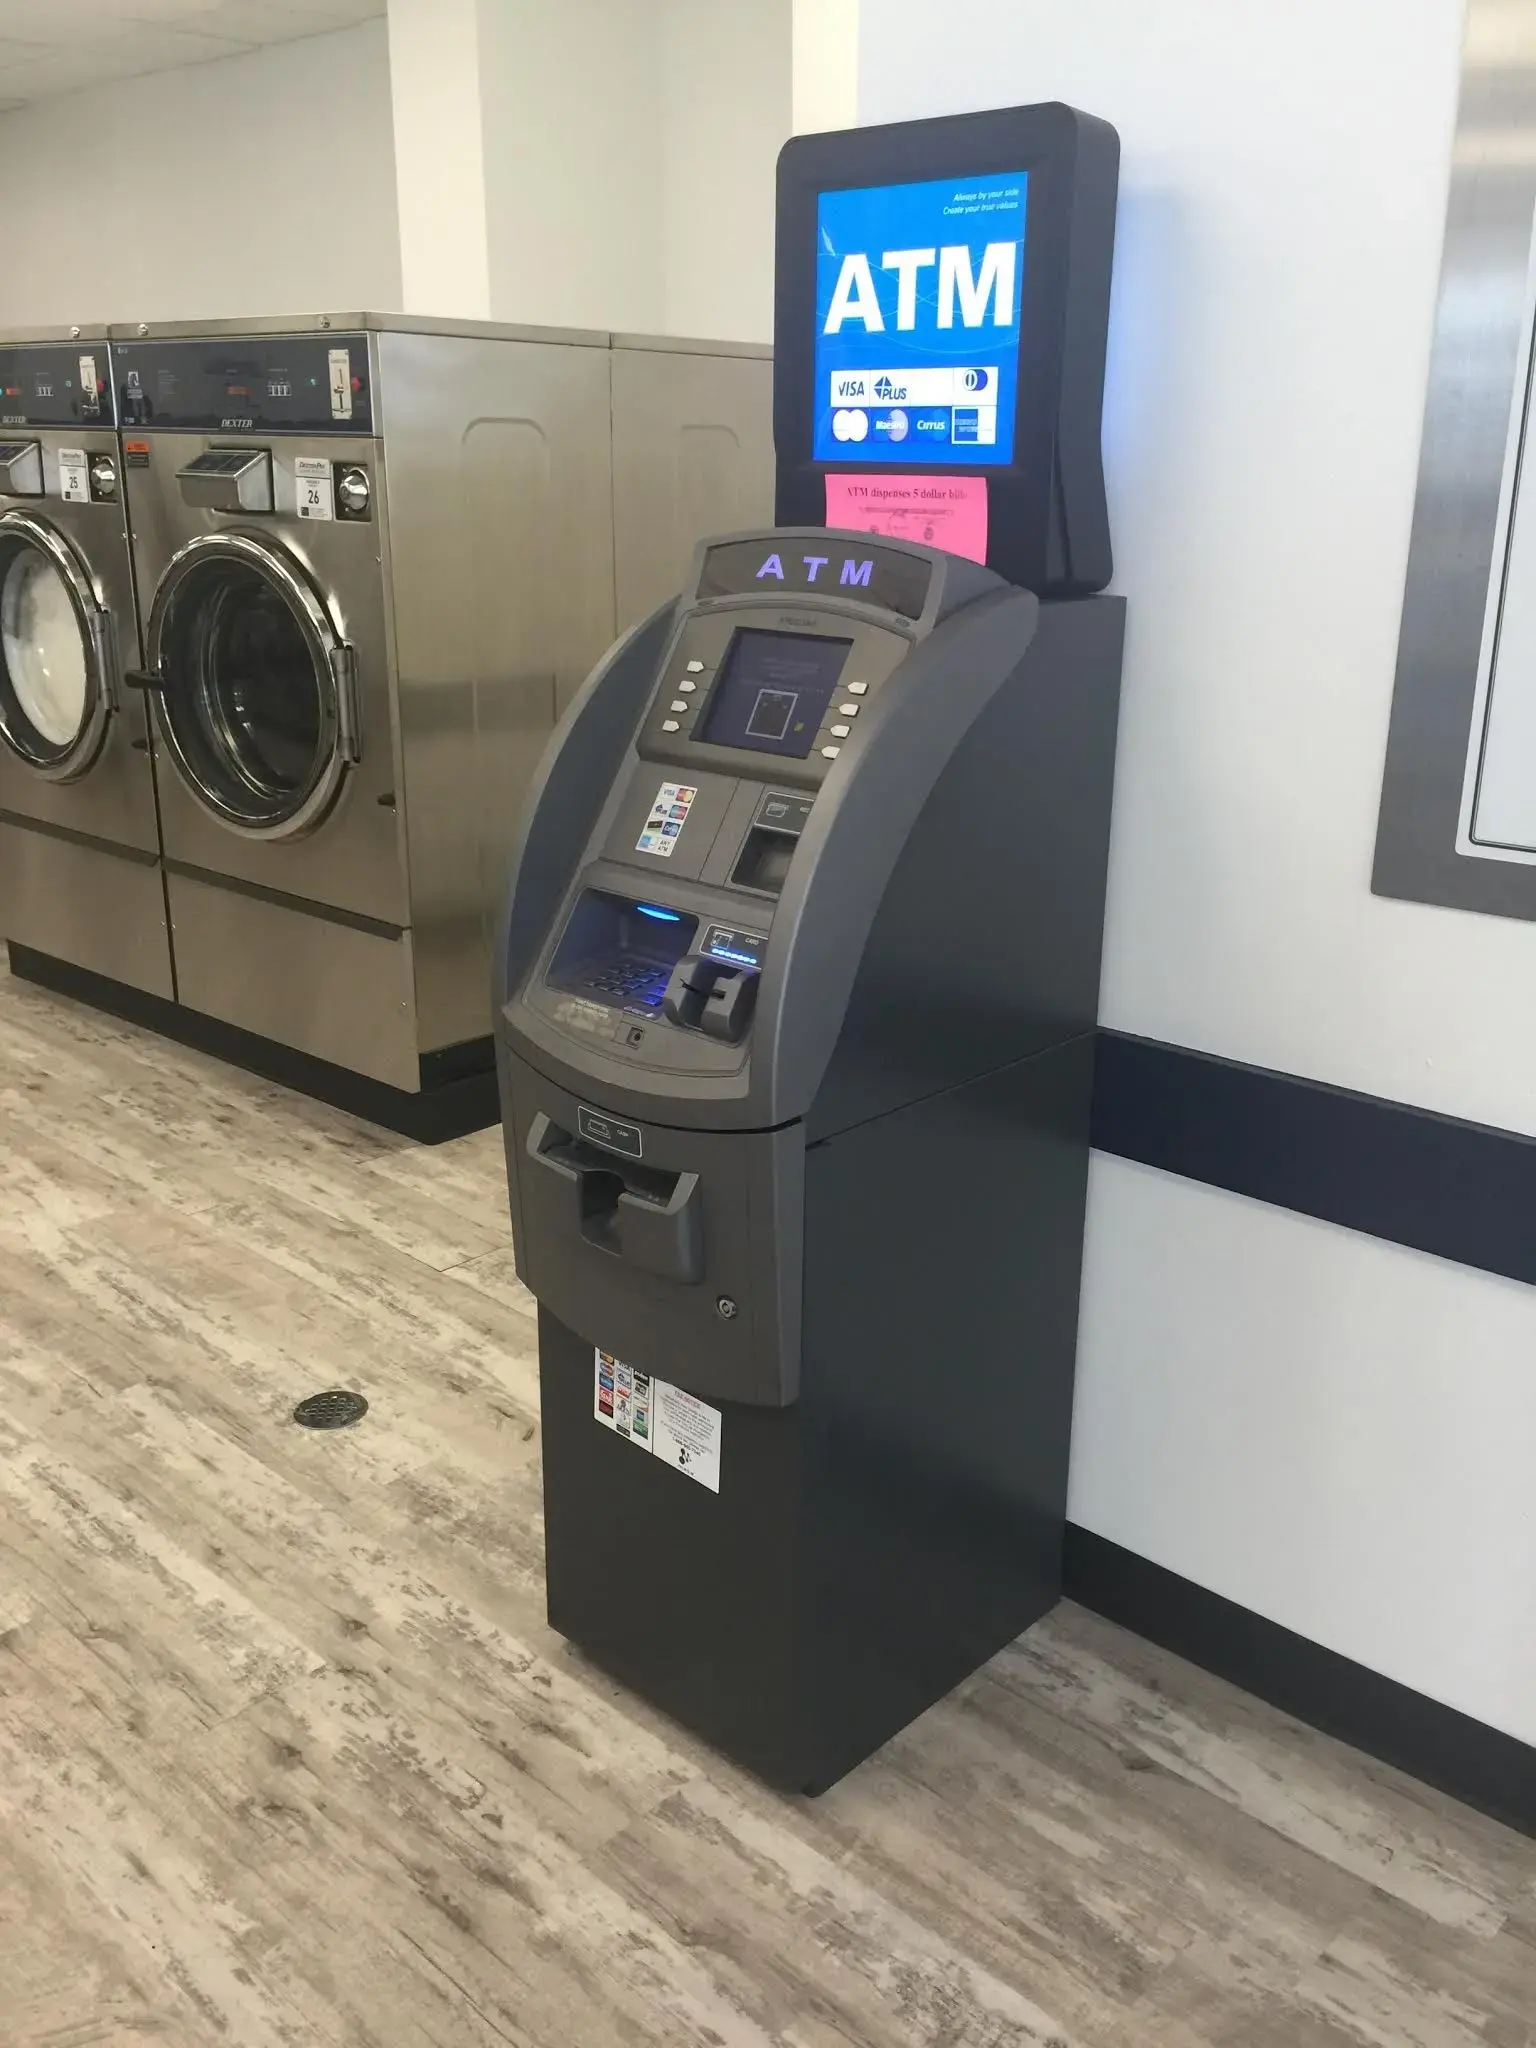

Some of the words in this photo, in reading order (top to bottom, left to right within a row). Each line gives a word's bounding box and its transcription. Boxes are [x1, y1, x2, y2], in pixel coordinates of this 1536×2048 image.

[953, 193, 977, 201] Always
[978, 192, 987, 200] by
[988, 191, 1003, 199] your
[1004, 188, 1019, 196] side
[943, 206, 964, 215] Create
[965, 205, 980, 214] your
[981, 204, 995, 212] true
[996, 201, 1018, 210] values
[823, 241, 1017, 335] ATM
[838, 381, 865, 396] VISA
[881, 387, 907, 400] PLUS
[3, 415, 26, 424] DEXTER
[221, 419, 253, 428] DEXTER
[875, 420, 905, 431] Maestro
[917, 419, 945, 430] Cirrus
[69, 476, 79, 489] 25
[307, 490, 320, 504] 26
[847, 487, 868, 498] ATM
[870, 487, 911, 500] dispenses
[913, 488, 919, 498] 5
[920, 488, 946, 499] dollar
[756, 553, 873, 587] ATM
[745, 937, 759, 946] CARD
